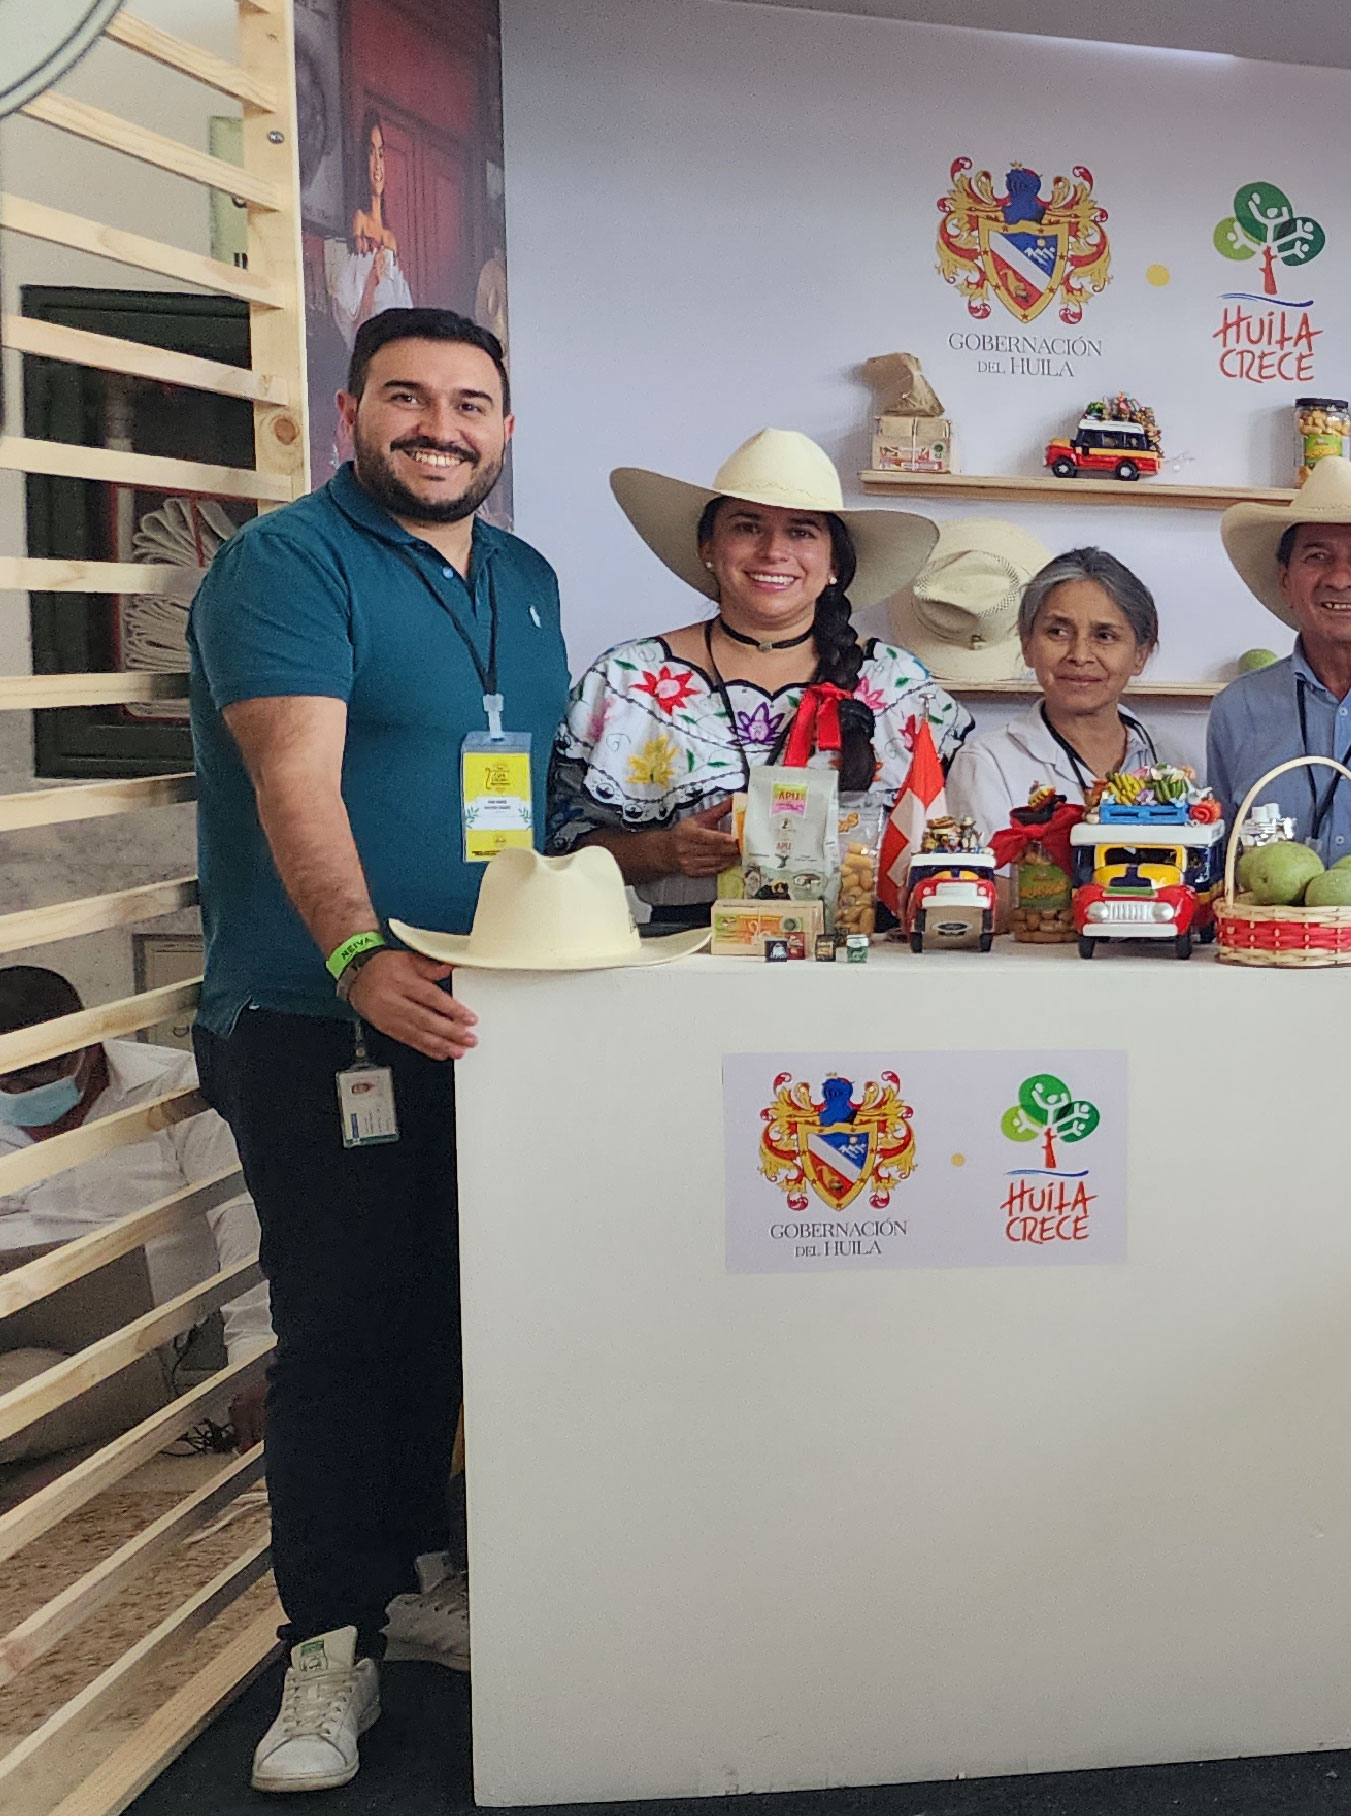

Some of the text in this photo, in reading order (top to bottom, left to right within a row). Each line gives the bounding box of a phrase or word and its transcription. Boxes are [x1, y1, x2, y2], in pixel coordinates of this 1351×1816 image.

[949, 333, 1102, 356] GOBERNACIÓN
[978, 357, 1075, 377] DEL HUILA
[1219, 348, 1314, 383] CRECE
[770, 1218, 907, 1240] GOBERNACIÓN
[1005, 1215, 1089, 1244] CRECE
[795, 1239, 882, 1258] DEL HUILA
